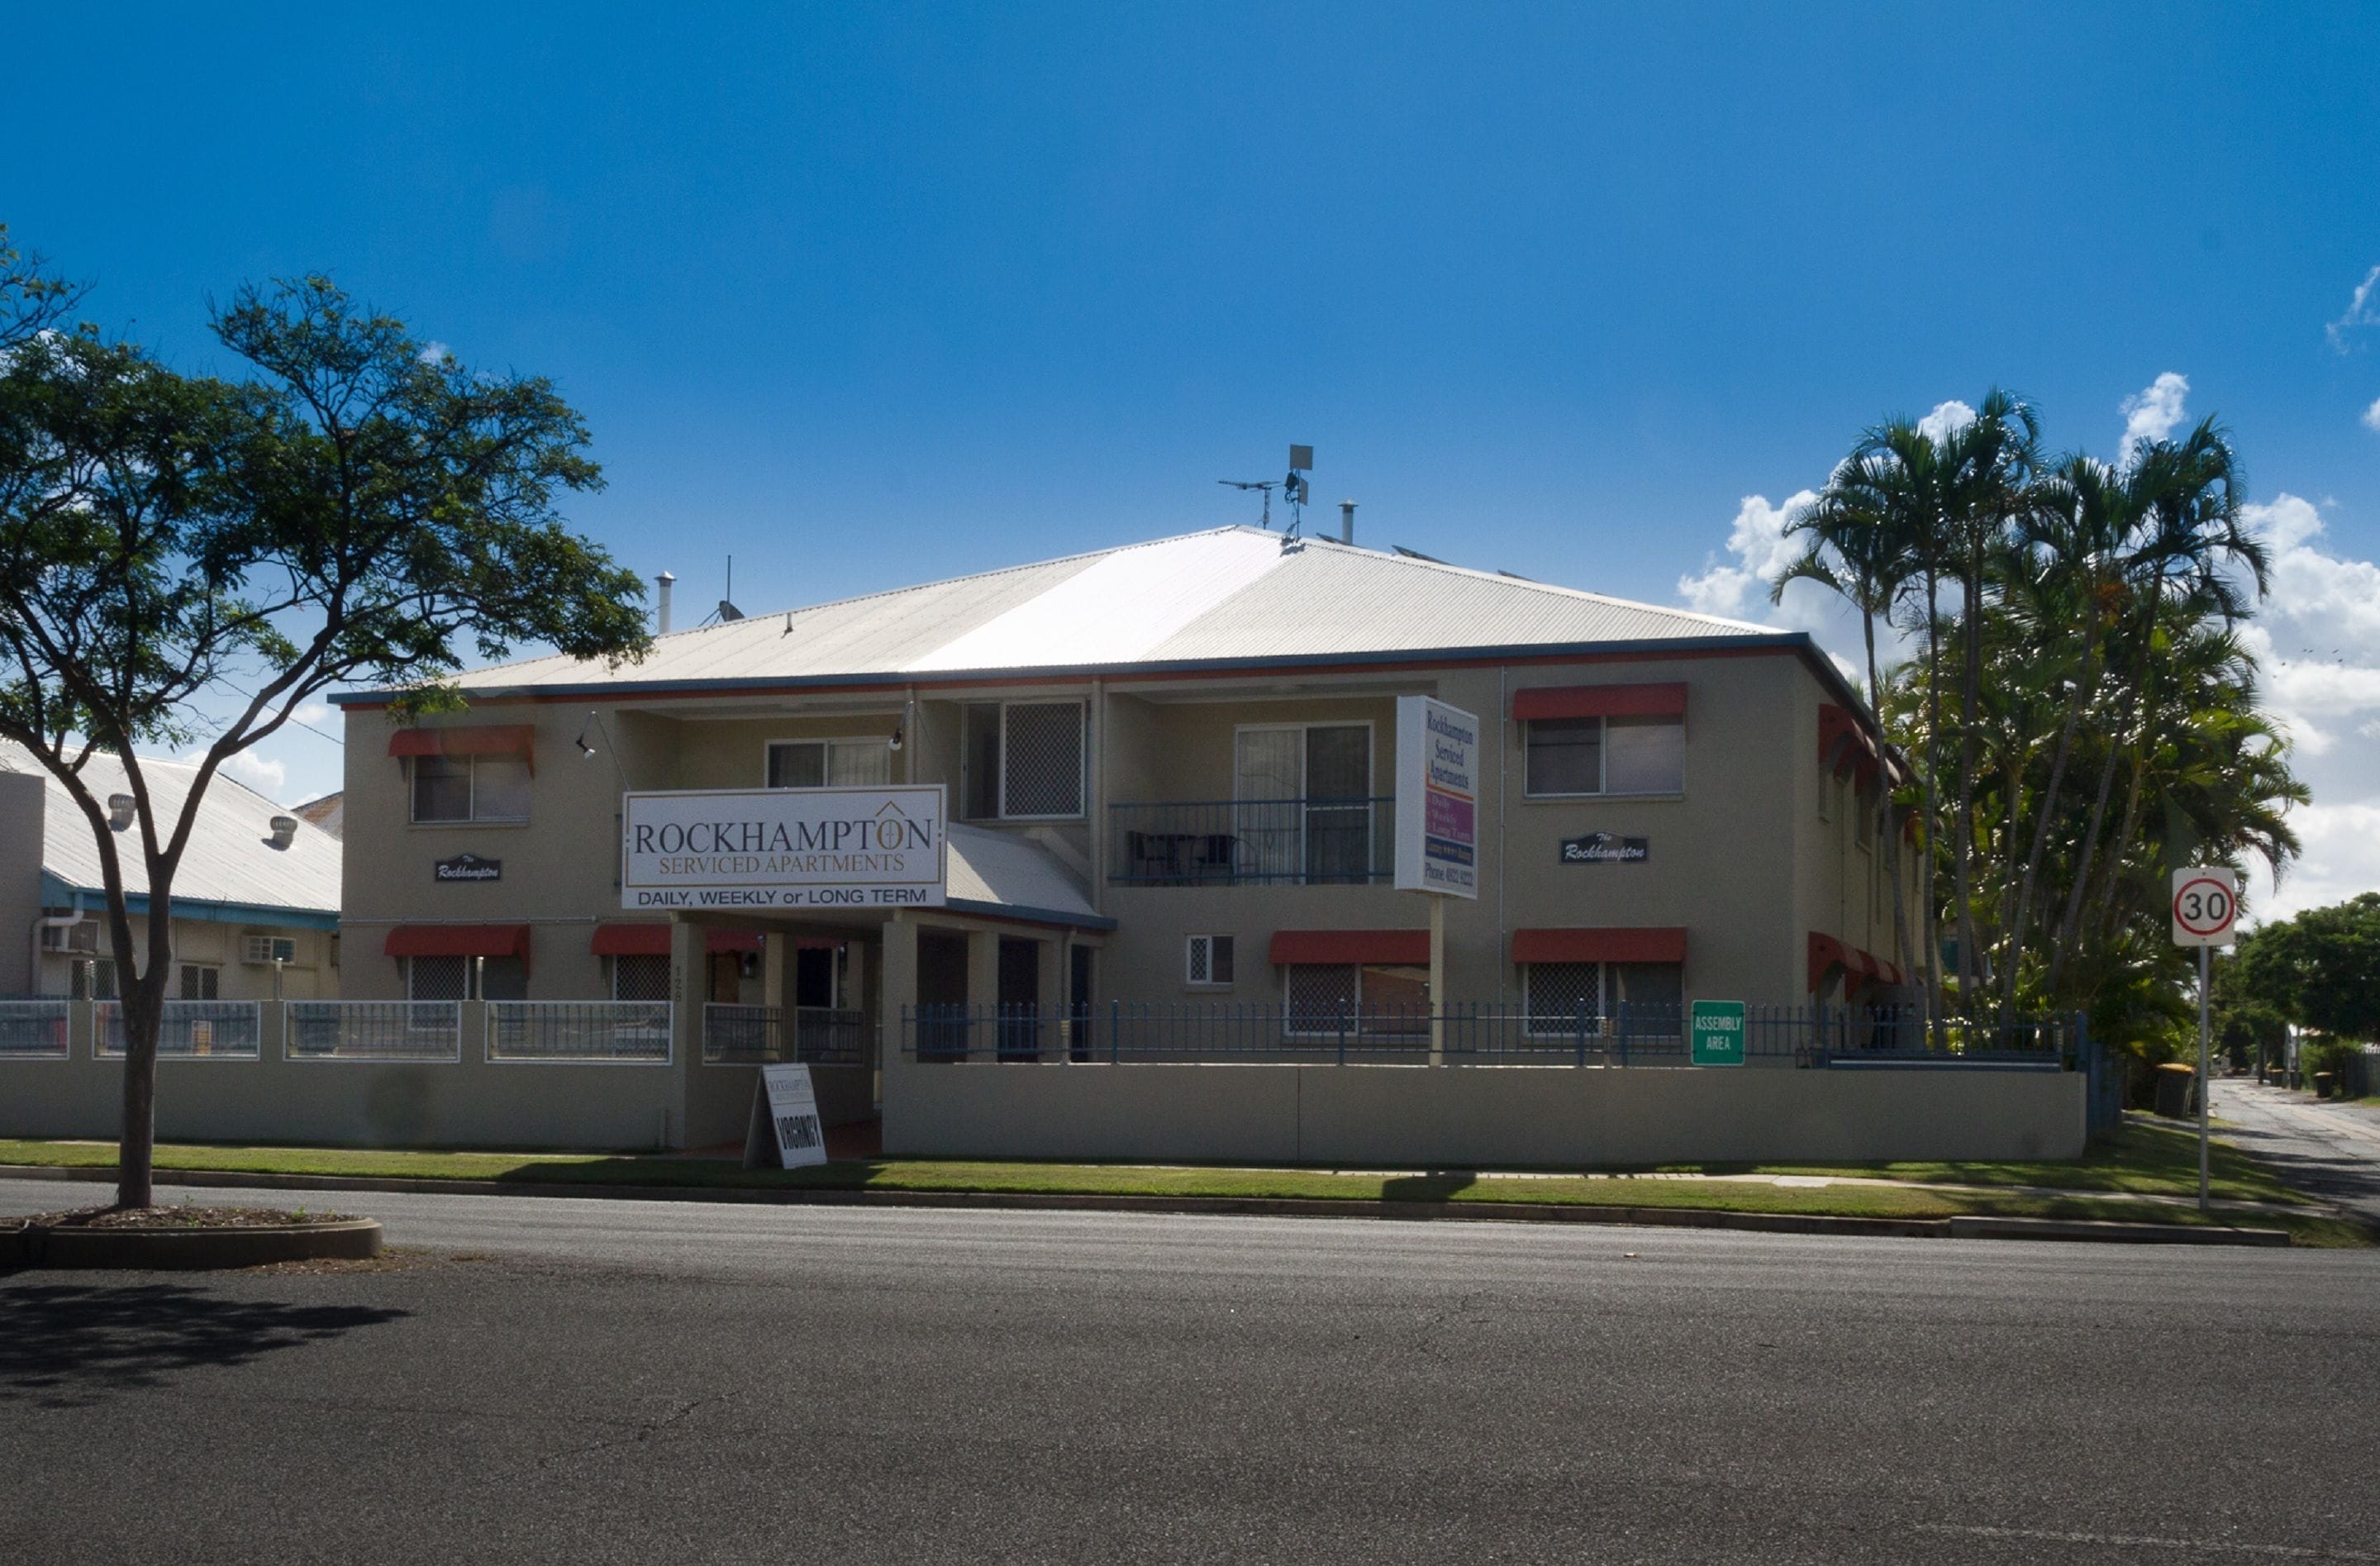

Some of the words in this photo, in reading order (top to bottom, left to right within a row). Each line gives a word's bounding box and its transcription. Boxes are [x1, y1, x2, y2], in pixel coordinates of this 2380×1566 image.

[634, 819, 935, 854] ROCKHAMPTON
[1597, 832, 1612, 841] The
[1565, 844, 1645, 861] Rockhampton
[438, 864, 498, 880] Rockhampton
[659, 855, 760, 874] SERVICED
[765, 854, 905, 873] APARTMENTS
[638, 891, 693, 907] DAILY,
[701, 890, 777, 905] WEEKLY
[783, 892, 803, 904] or
[809, 889, 864, 903] LONG
[870, 888, 926, 902] TERM
[2183, 892, 2226, 921] 30
[1695, 1016, 1742, 1031] ASSEMBLY
[1706, 1035, 1731, 1050] AREA
[776, 1113, 821, 1150] VACANCY
